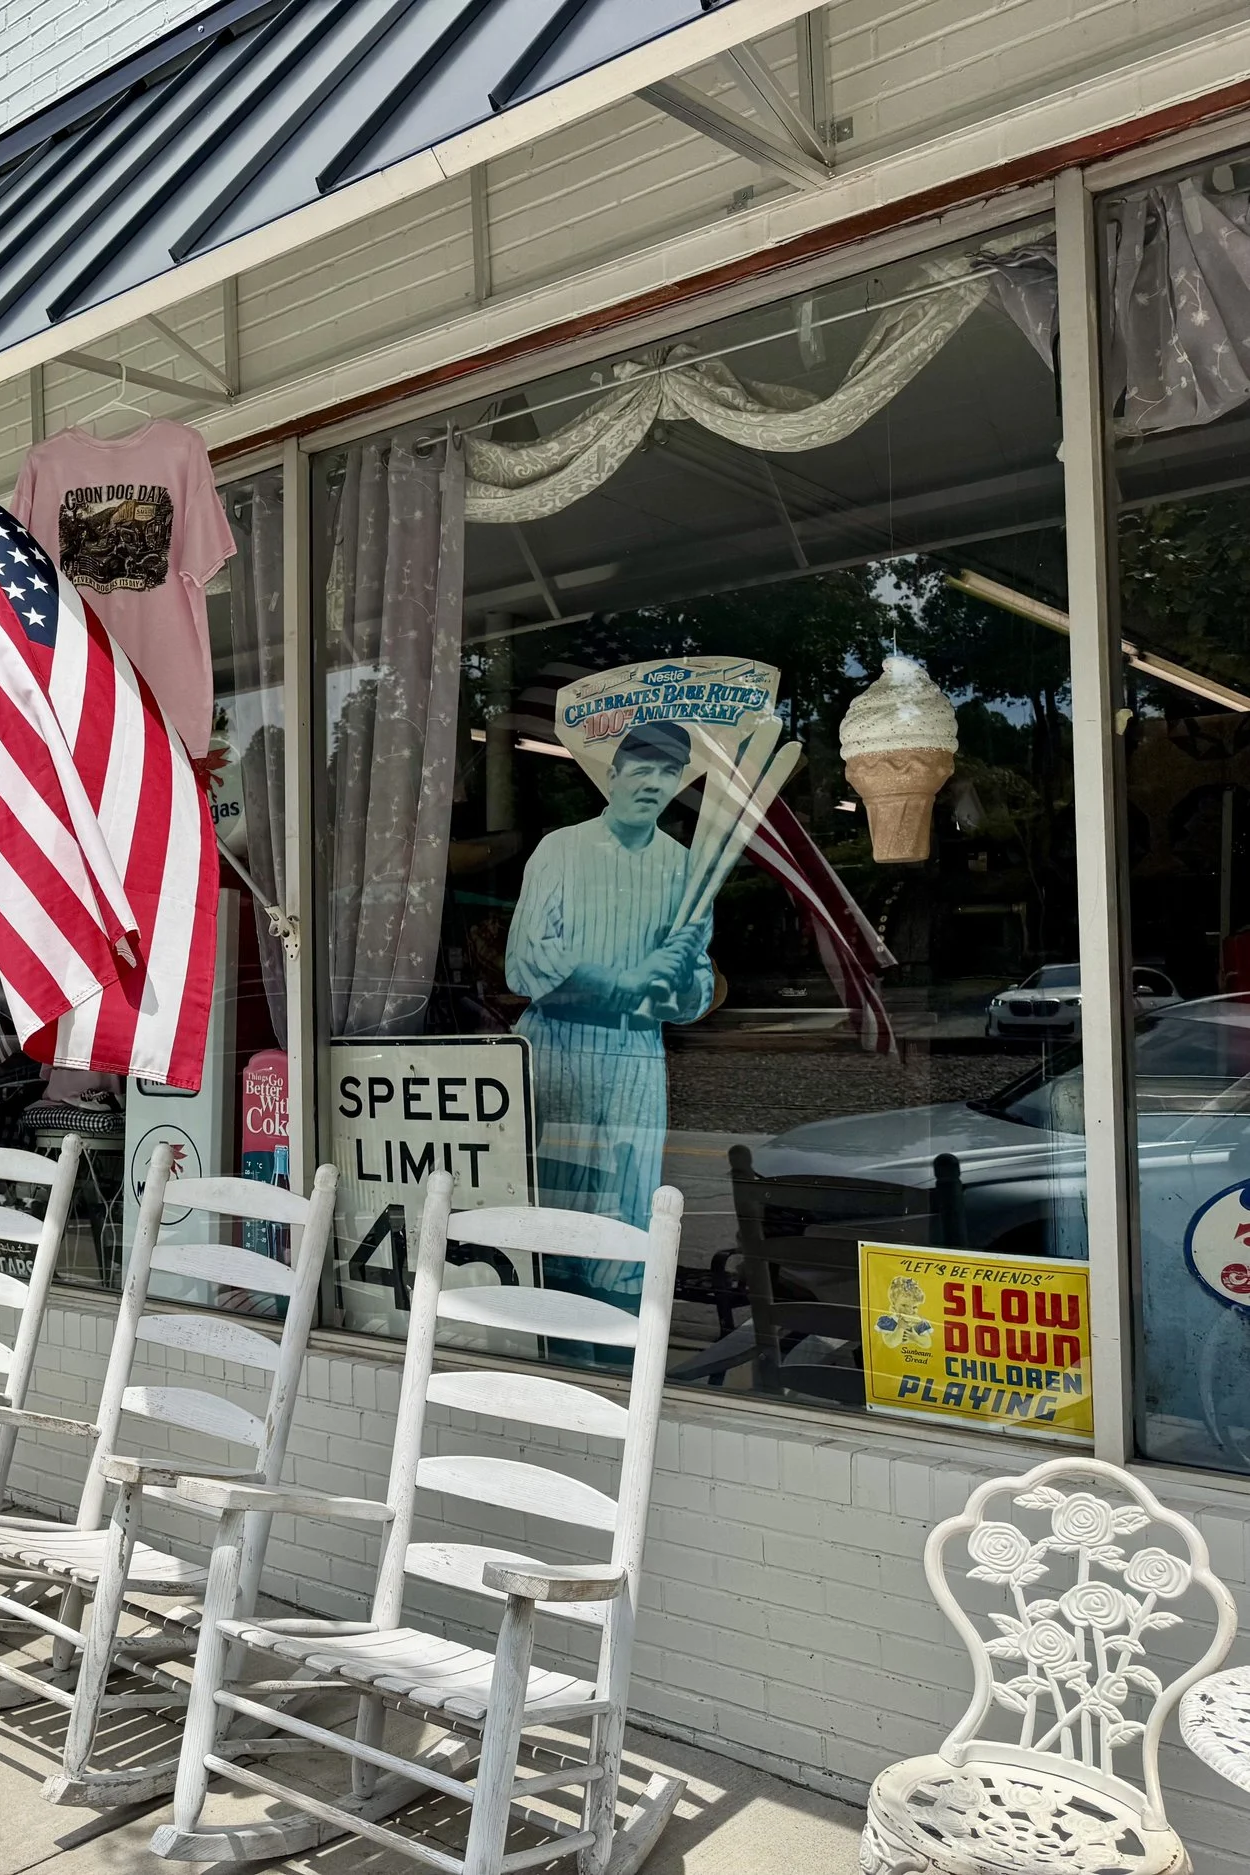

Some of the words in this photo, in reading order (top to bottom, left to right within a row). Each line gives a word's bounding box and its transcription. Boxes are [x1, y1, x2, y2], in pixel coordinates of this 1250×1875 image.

[65, 486, 103, 511] COON
[106, 484, 135, 500] DOG
[96, 583, 109, 592] DOG
[129, 580, 139, 588] DAY
[564, 686, 661, 724] CELEBRATES
[662, 682, 704, 705] BABE
[705, 682, 767, 706] RUTH'S
[631, 702, 738, 724] ANNIVERSARY
[245, 1080, 283, 1097] Better
[248, 1072, 269, 1083] Things
[268, 1073, 284, 1087] Go
[338, 1075, 511, 1122] SPEED
[356, 1138, 490, 1188] LIMIT
[950, 1265, 970, 1279] BE
[943, 1281, 1080, 1330] SLOW
[904, 1354, 928, 1365] Bread
[943, 1320, 1082, 1369] DOWN
[945, 1356, 1083, 1395] CHILDREN
[897, 1374, 1057, 1421] PLAYING
